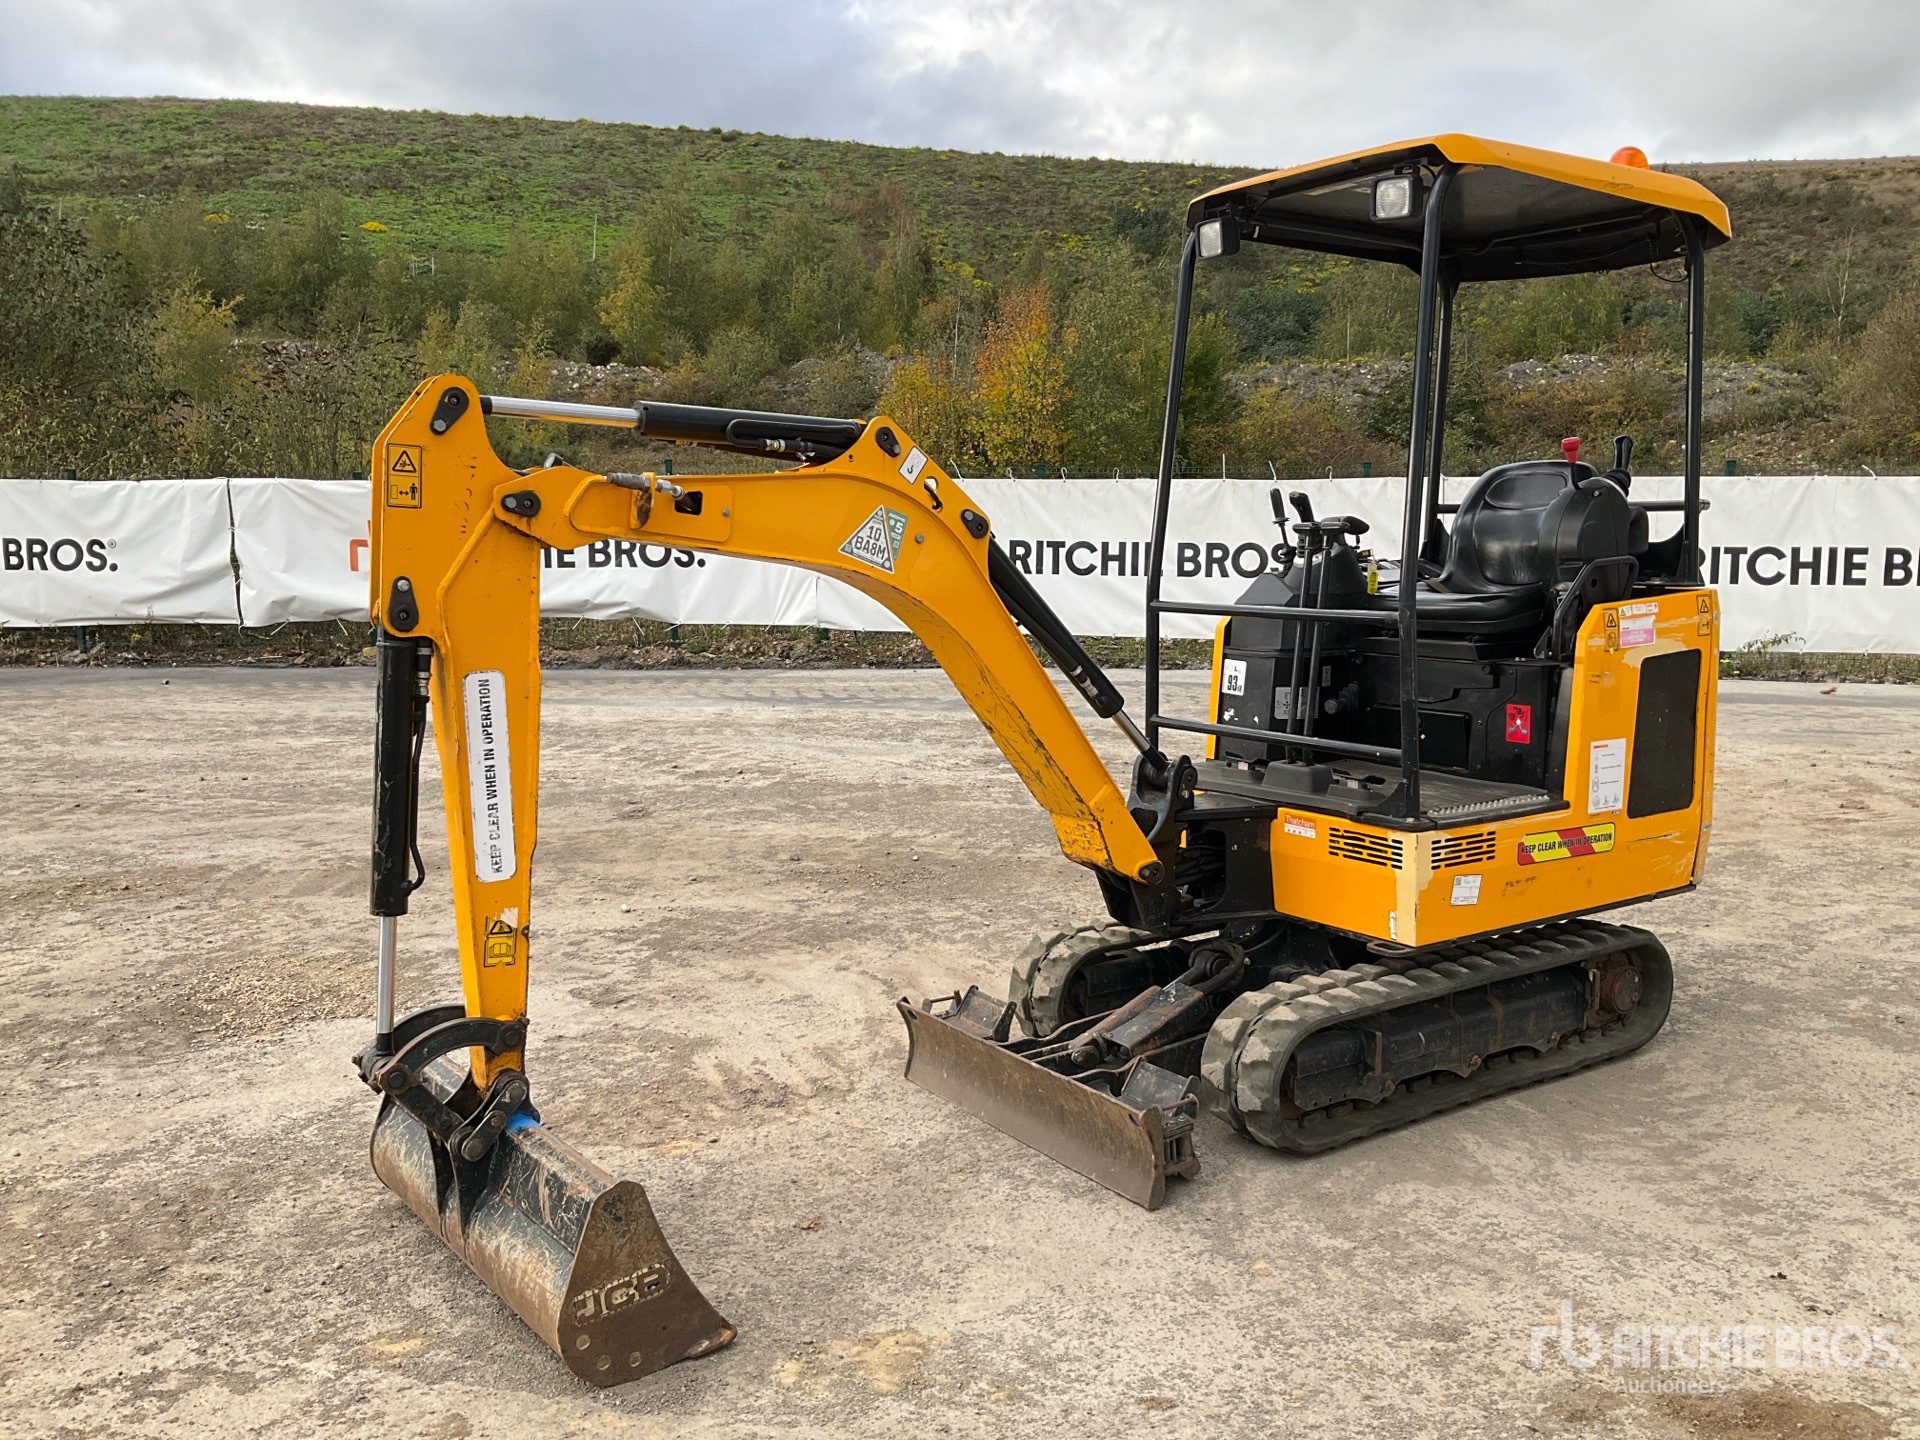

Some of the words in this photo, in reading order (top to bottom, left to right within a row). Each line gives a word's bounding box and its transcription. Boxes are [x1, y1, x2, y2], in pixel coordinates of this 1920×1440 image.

[894, 521, 904, 534] 5
[854, 535, 887, 560] BA8M
[1227, 674, 1239, 692] 93
[478, 678, 493, 745] OPERATION
[484, 748, 495, 760] IN
[484, 764, 498, 801] WHEN
[487, 802, 501, 840] CLEAR
[1521, 844, 1536, 854] KEEP
[1537, 841, 1556, 852] CLEAR
[1557, 839, 1574, 849] WHEN
[1575, 837, 1582, 846] IN
[1583, 833, 1612, 845] OPERATION
[489, 845, 503, 873] KEEP
